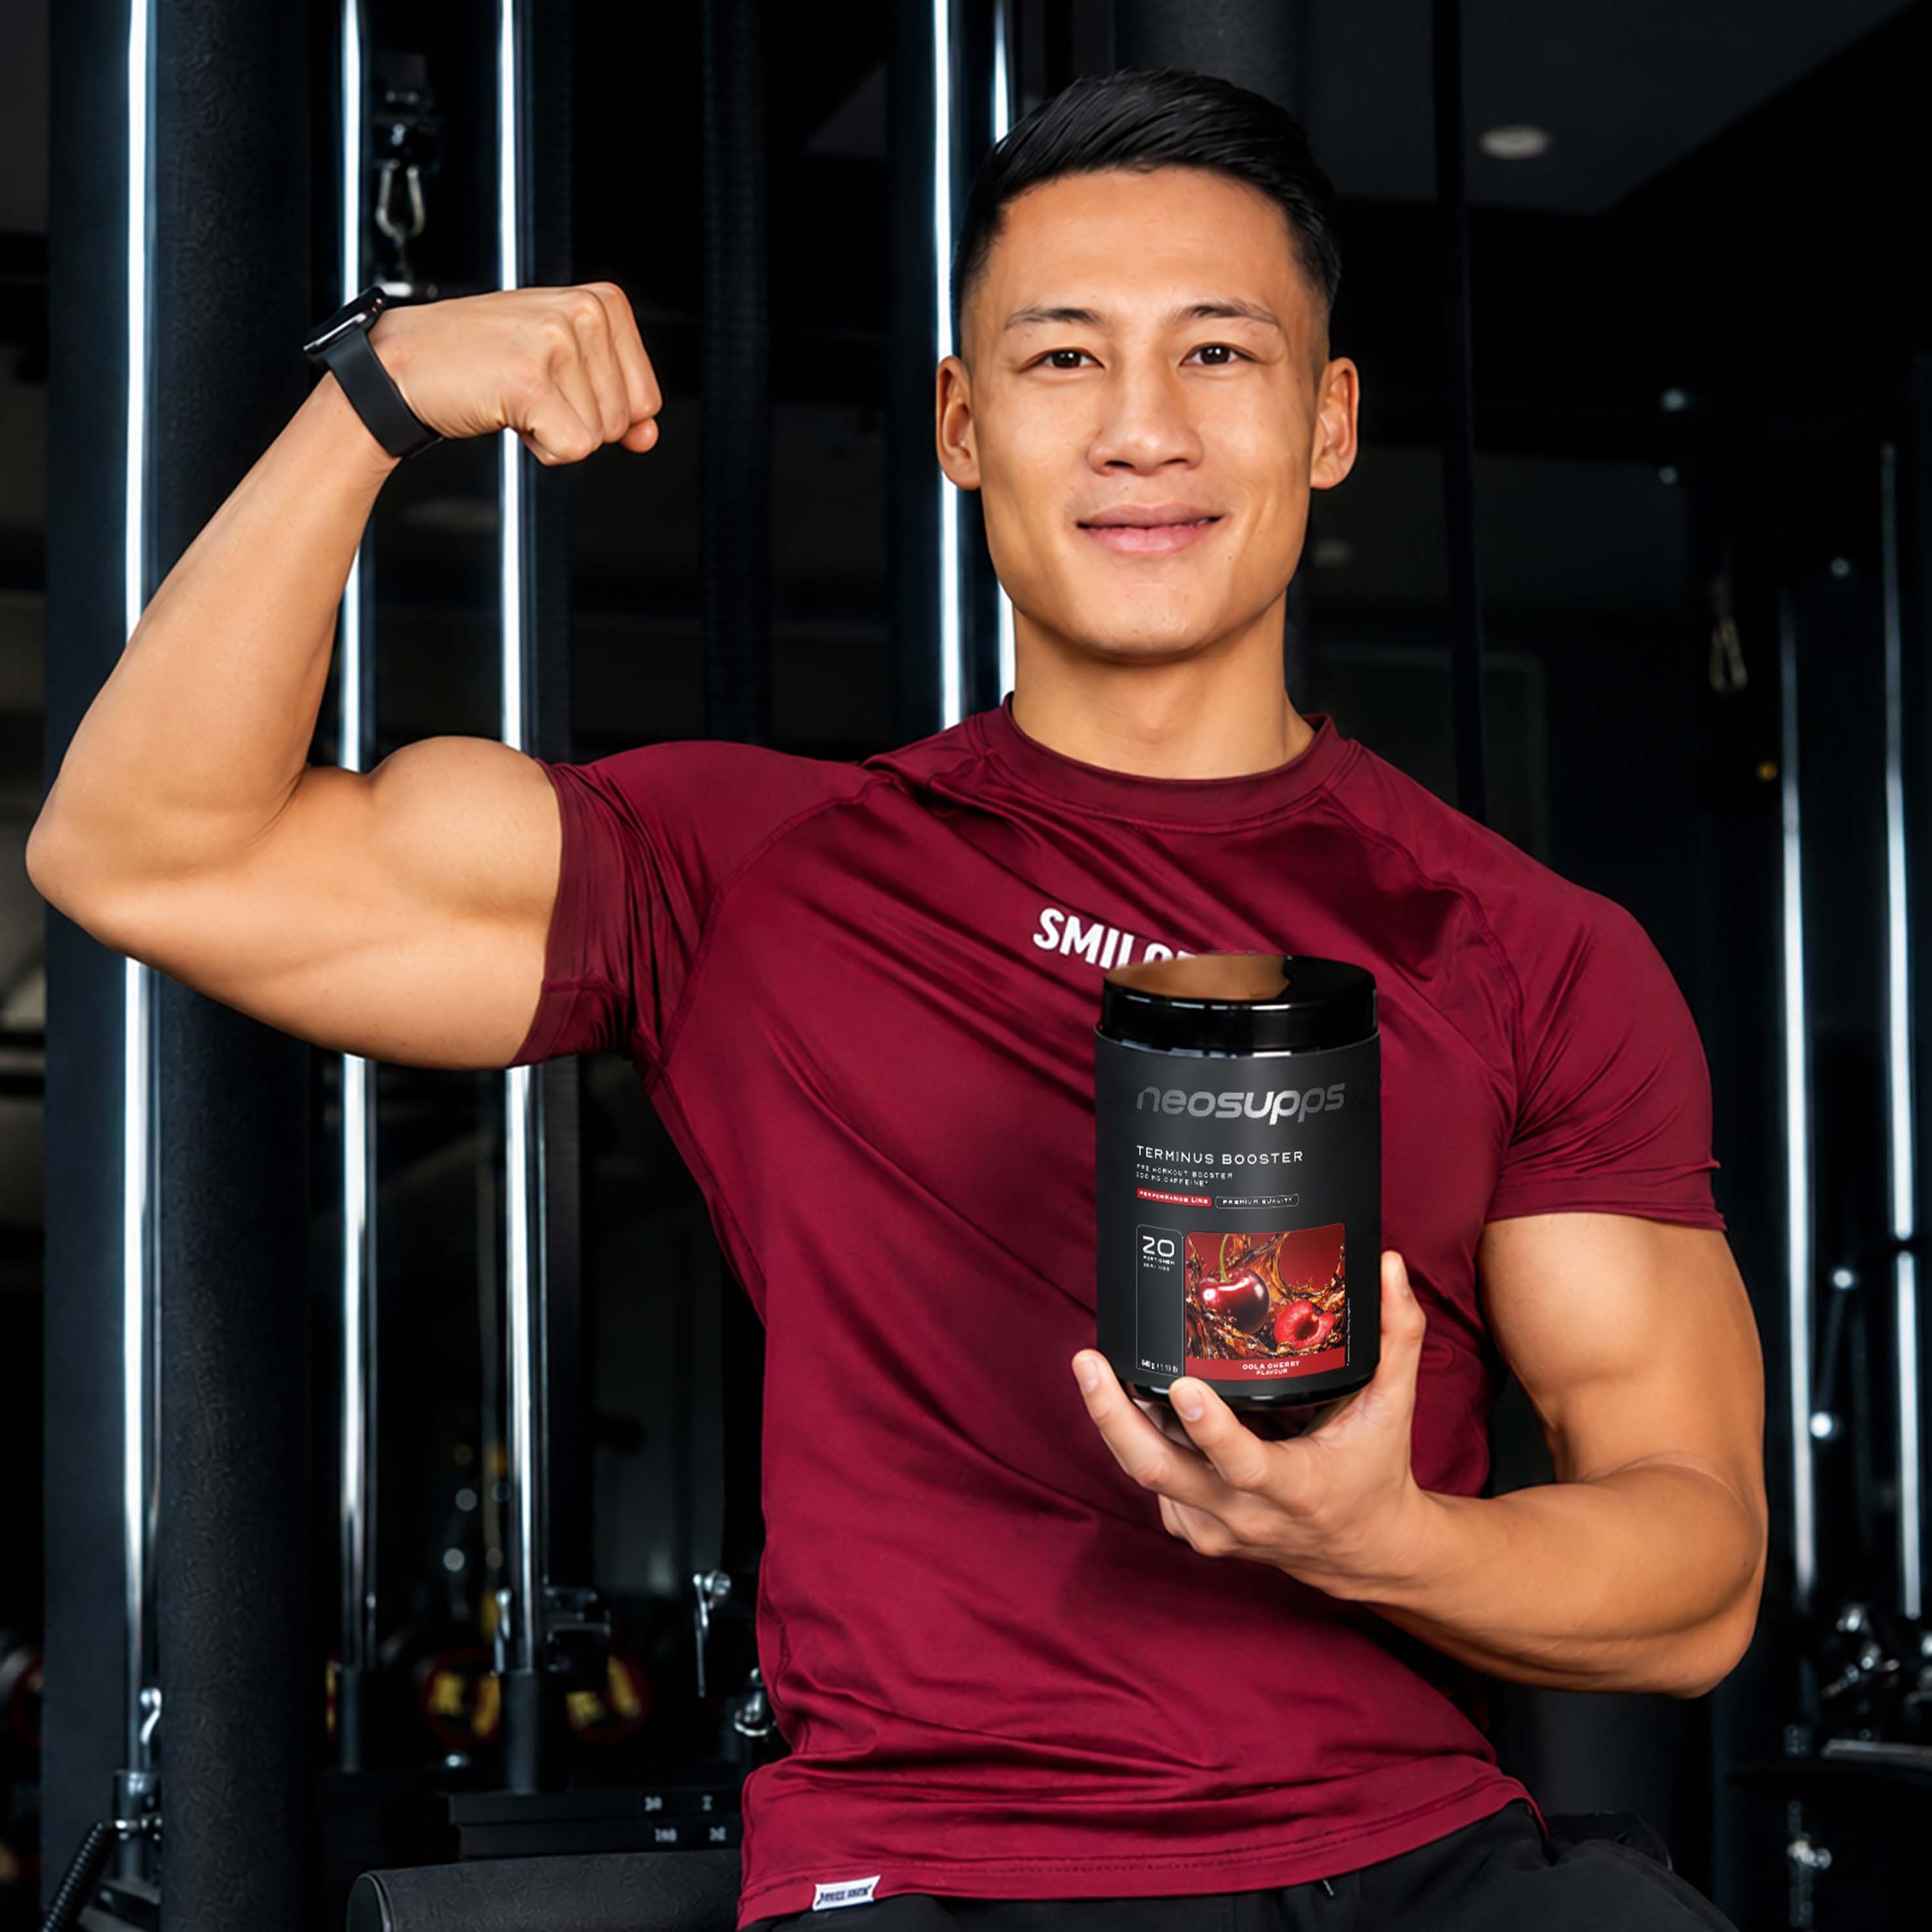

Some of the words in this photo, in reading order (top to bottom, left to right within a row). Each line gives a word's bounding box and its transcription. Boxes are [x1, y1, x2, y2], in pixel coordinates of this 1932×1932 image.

[1033, 907, 1197, 970] SMIL
[1136, 1082, 1346, 1125] neosupps
[1136, 1145, 1214, 1164] TERMINUS
[1222, 1151, 1303, 1165] BOOSTER
[1192, 1171, 1233, 1180] BOOSTER
[1143, 1236, 1175, 1257] 20
